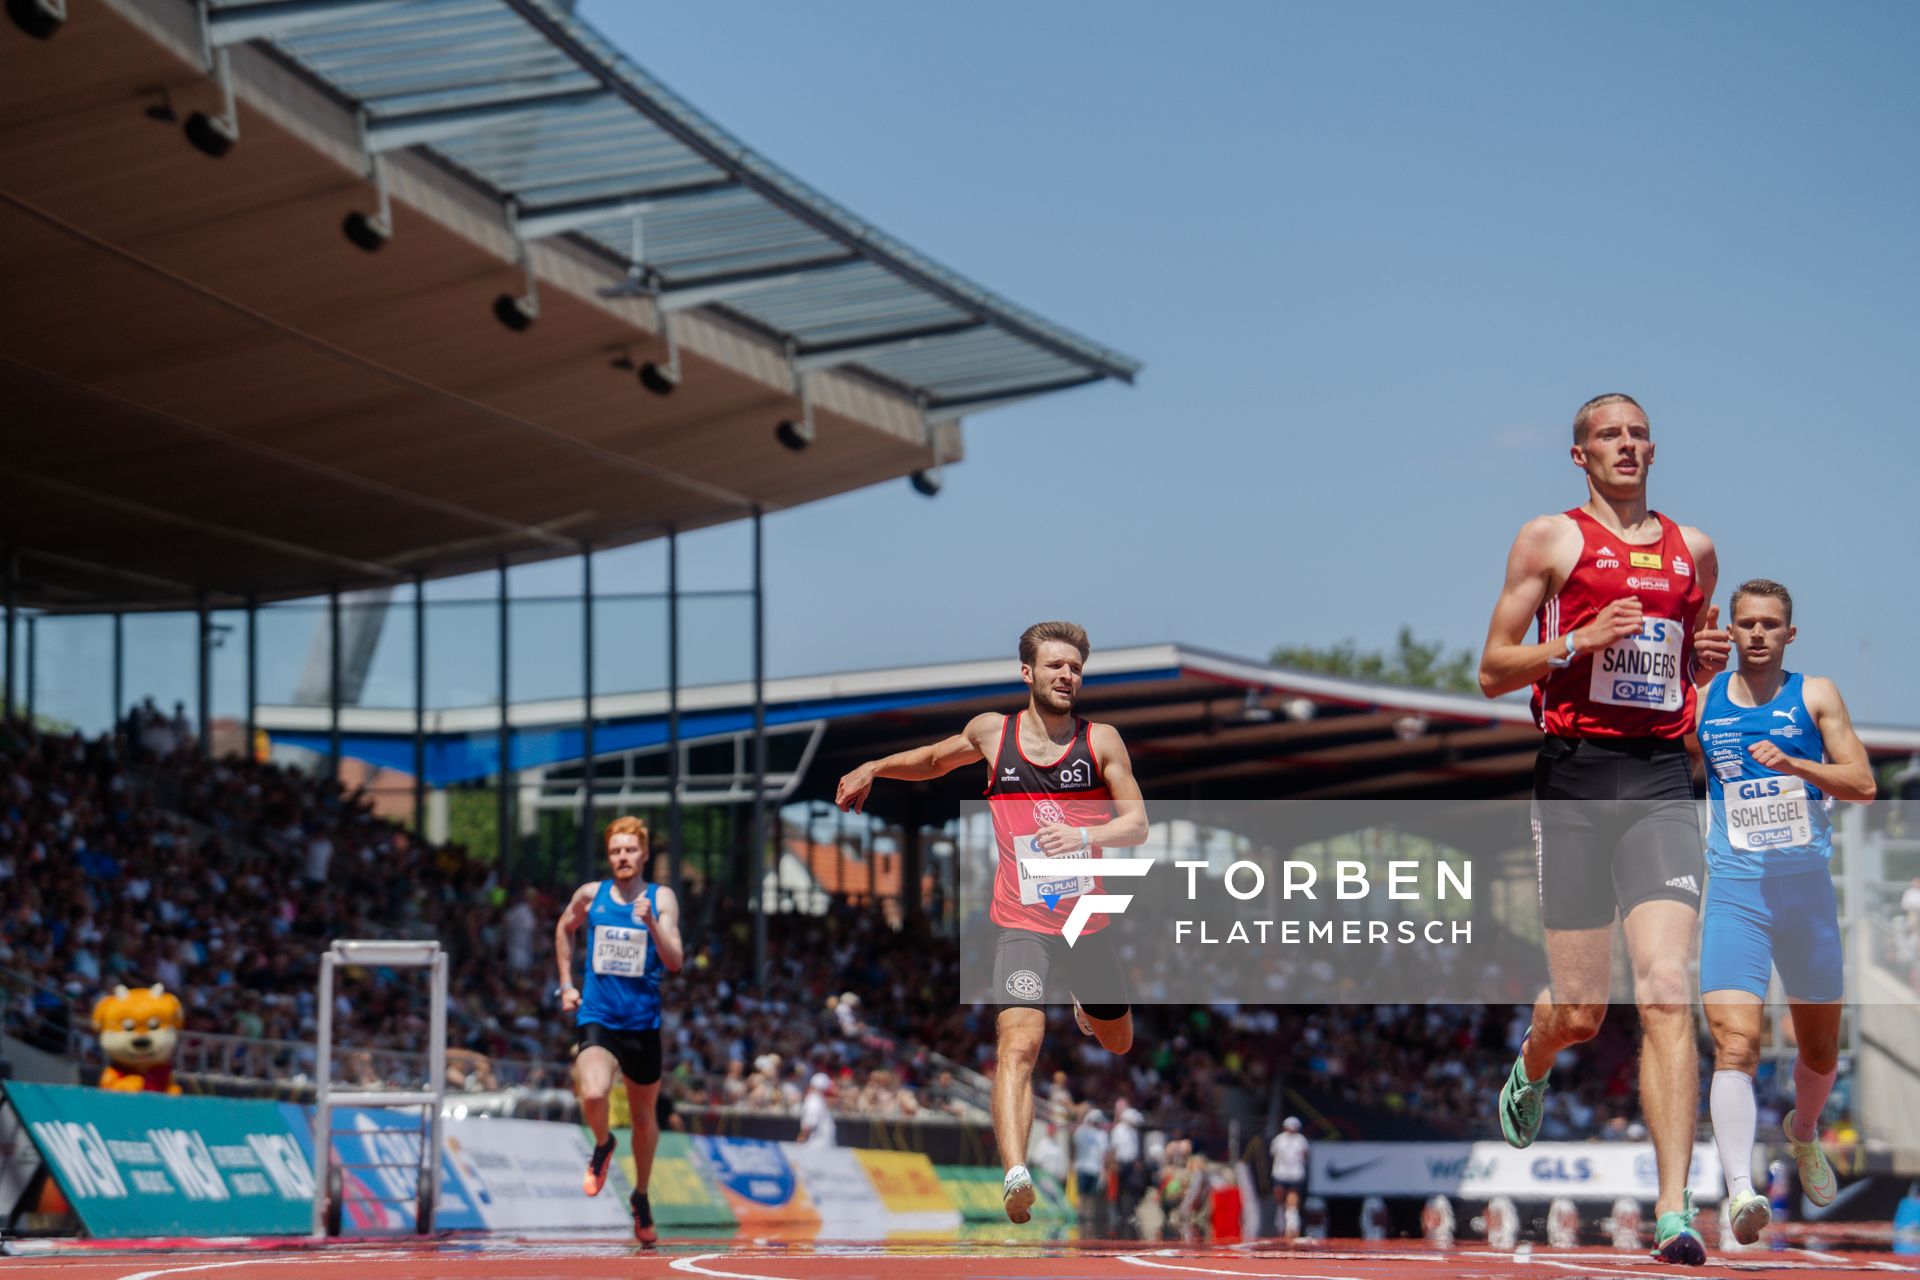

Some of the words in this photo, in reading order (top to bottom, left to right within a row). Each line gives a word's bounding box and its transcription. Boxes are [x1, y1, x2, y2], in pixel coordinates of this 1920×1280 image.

[1623, 621, 1666, 642] LS
[1602, 647, 1676, 679] SANDERS
[1637, 685, 1664, 697] PLAN
[1060, 768, 1083, 783] OS
[1738, 779, 1780, 800] GLS
[1731, 801, 1803, 828] SCHLEGEL
[1765, 829, 1790, 840] PLAN
[1054, 880, 1077, 891] PLAN
[605, 929, 630, 941] GLS
[598, 943, 640, 960] STRAUCH
[1531, 1156, 1593, 1181] GLS
